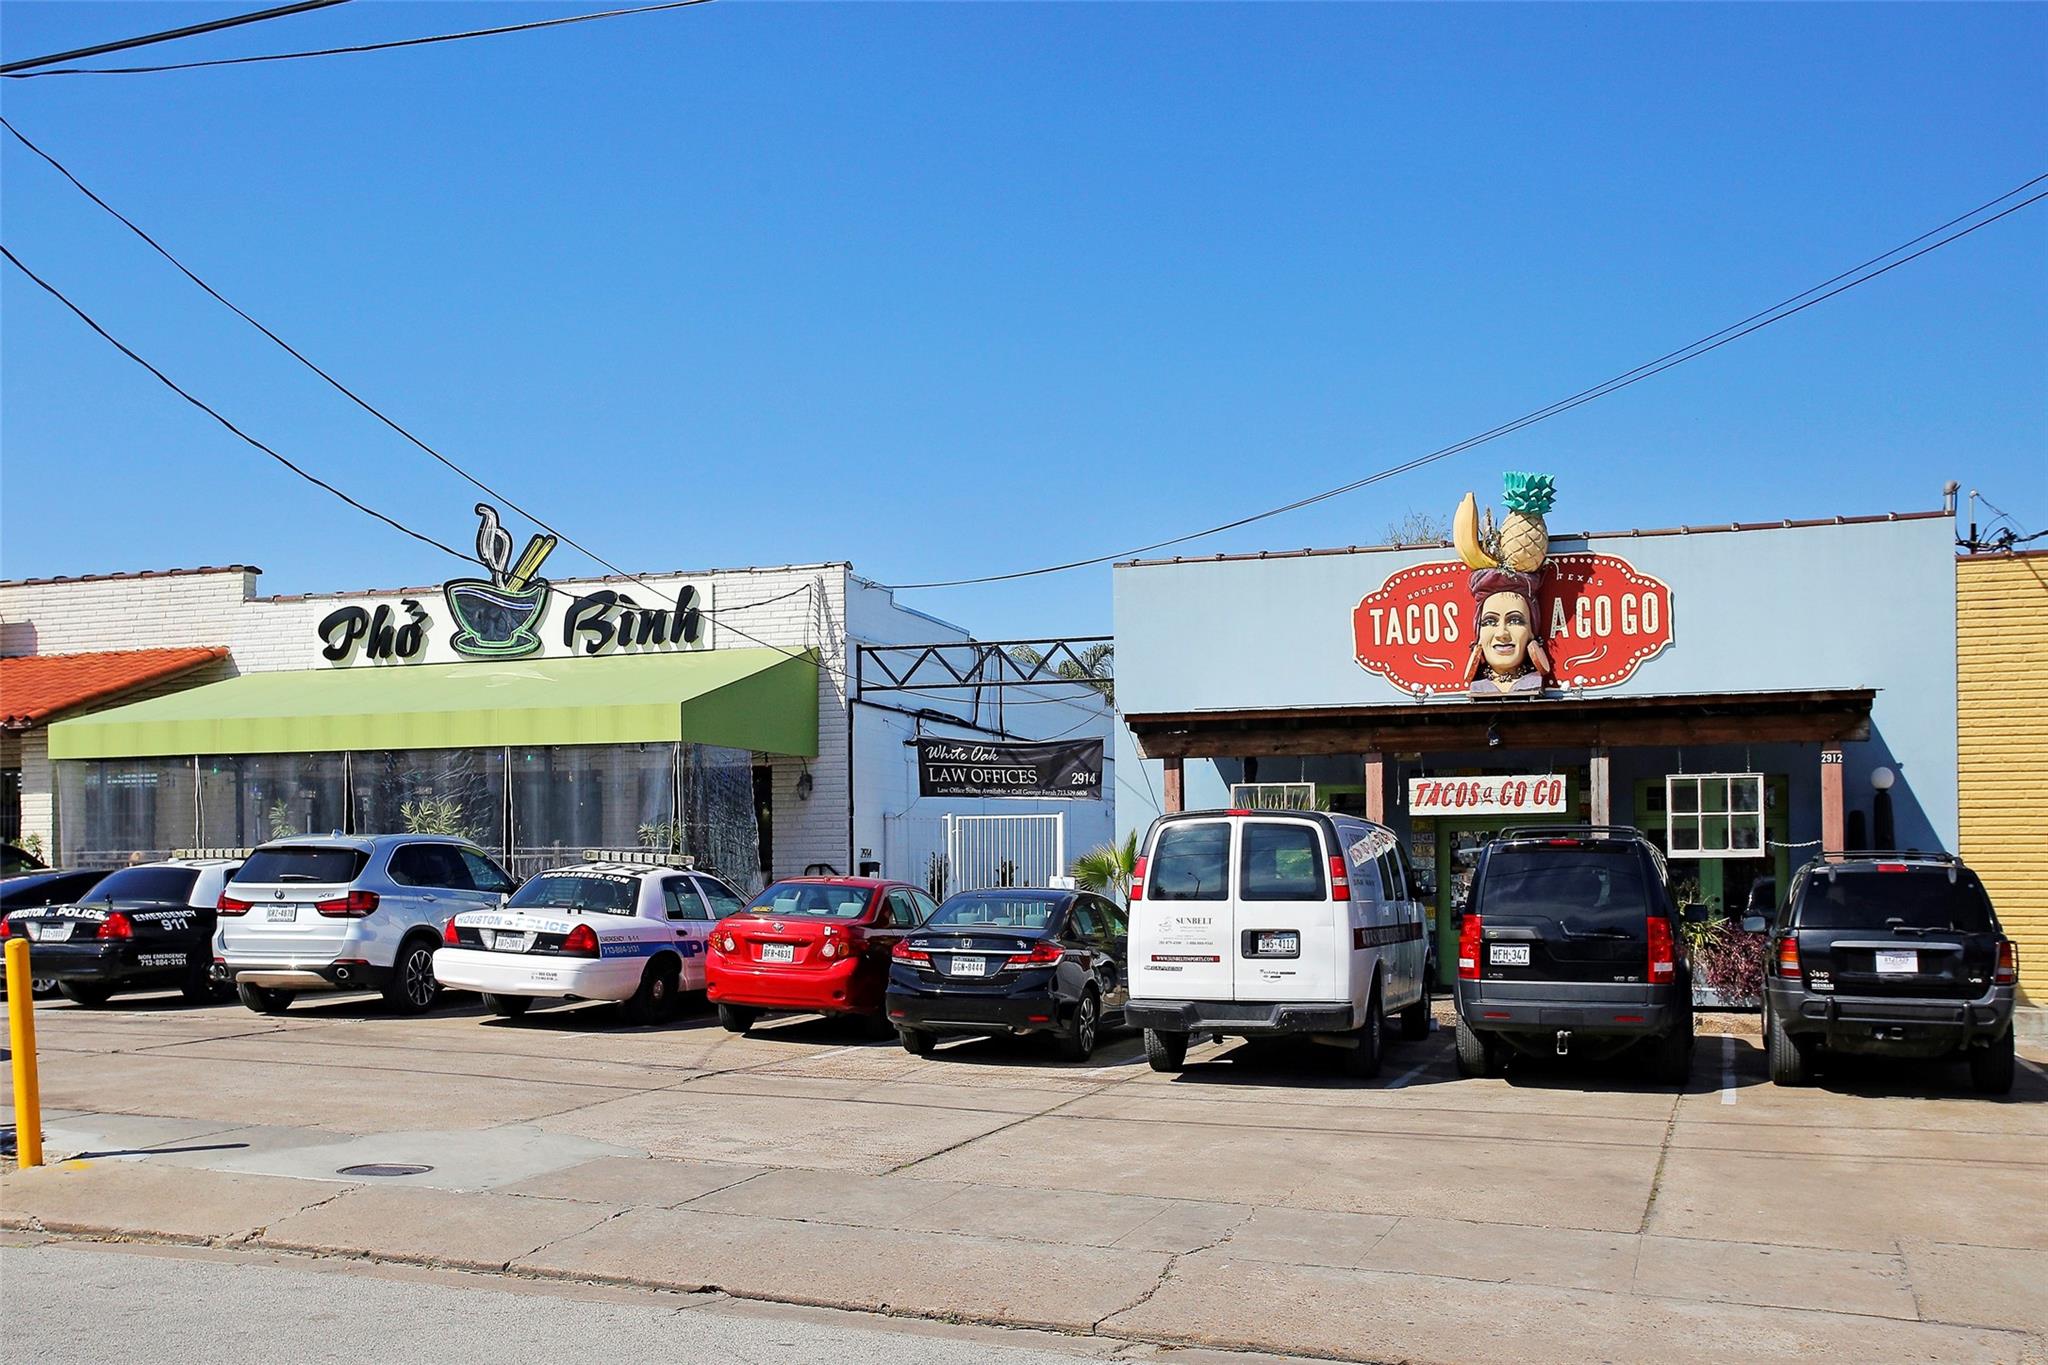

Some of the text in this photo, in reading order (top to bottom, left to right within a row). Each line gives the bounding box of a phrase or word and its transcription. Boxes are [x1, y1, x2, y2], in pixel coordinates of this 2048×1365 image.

[1407, 573, 1603, 600] HOUSTON TEXAS
[1369, 591, 1659, 646] TACOS A GO GO
[925, 744, 999, 762] White Oak
[1821, 753, 1843, 763] 2912
[929, 767, 1038, 784] LAW OFFICES
[1071, 772, 1096, 785] 2914
[1414, 782, 1481, 807] TACOS
[1499, 781, 1527, 807] GO
[1533, 779, 1562, 806] GO
[8, 907, 106, 920] HOUSTON POLICE
[132, 910, 197, 922] EMERGENCY
[161, 918, 189, 931] 911
[457, 915, 570, 933] HOUSTON POLICE
[1809, 970, 1829, 978] Jeep
